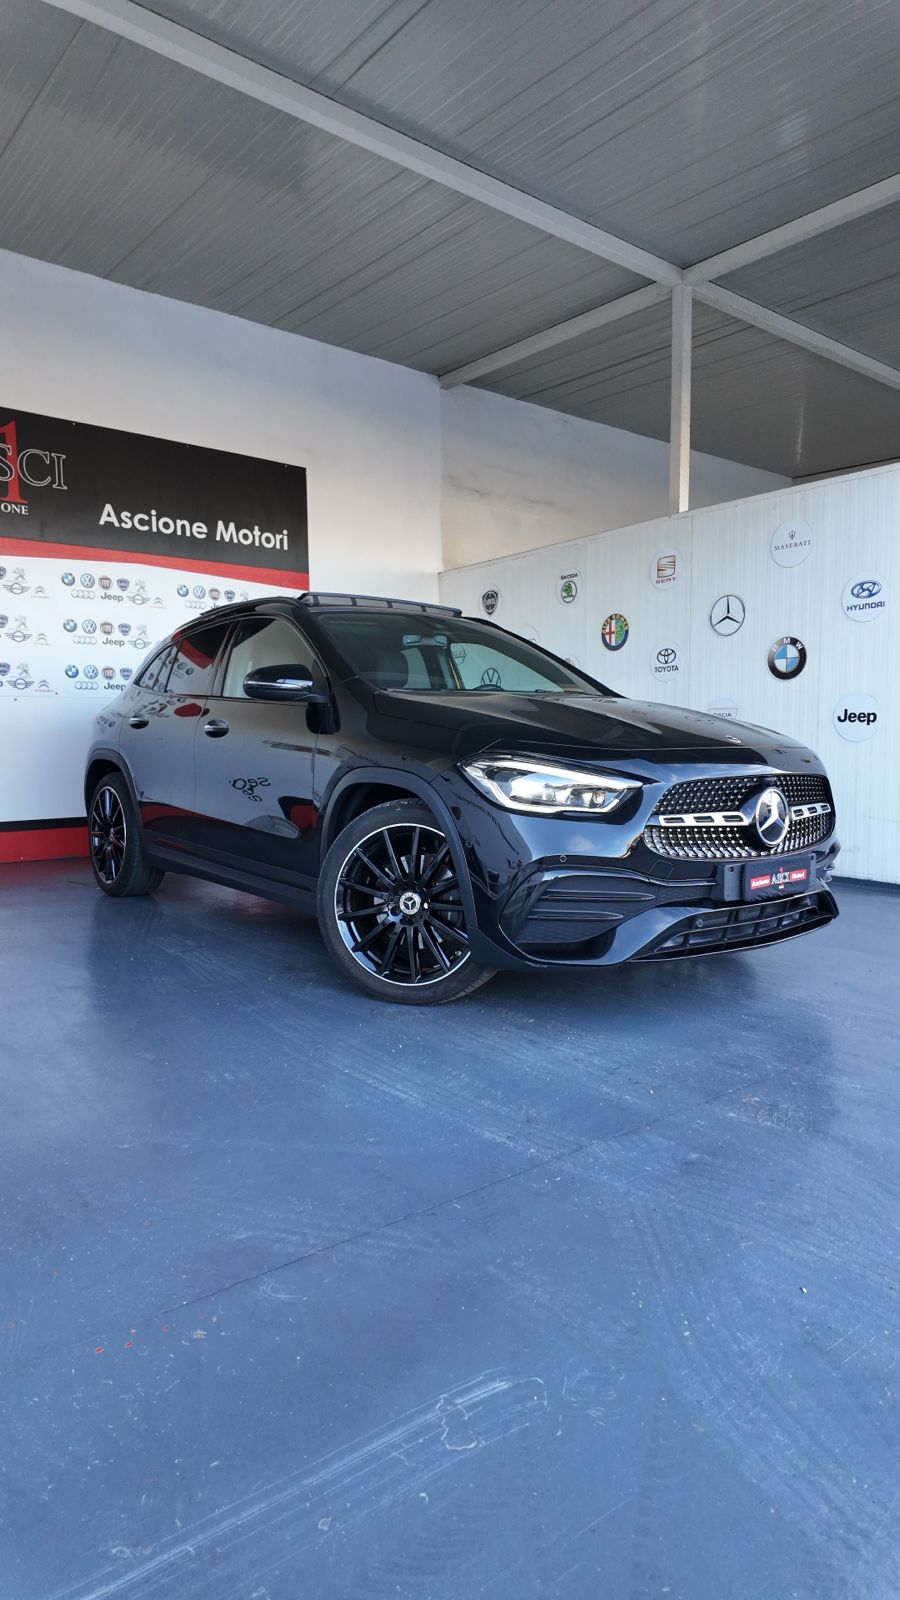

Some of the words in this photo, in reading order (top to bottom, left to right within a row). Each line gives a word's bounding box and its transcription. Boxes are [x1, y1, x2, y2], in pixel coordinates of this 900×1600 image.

[99, 503, 208, 539] Ascione
[215, 520, 288, 550] Motori
[773, 539, 811, 551] MASERATI
[100, 592, 123, 603] Jeep
[846, 600, 886, 611] HYUNDAI
[102, 637, 125, 648] Jeep
[772, 637, 803, 651] BMW
[654, 665, 679, 673] TOYOTA
[837, 709, 877, 725] Jeep
